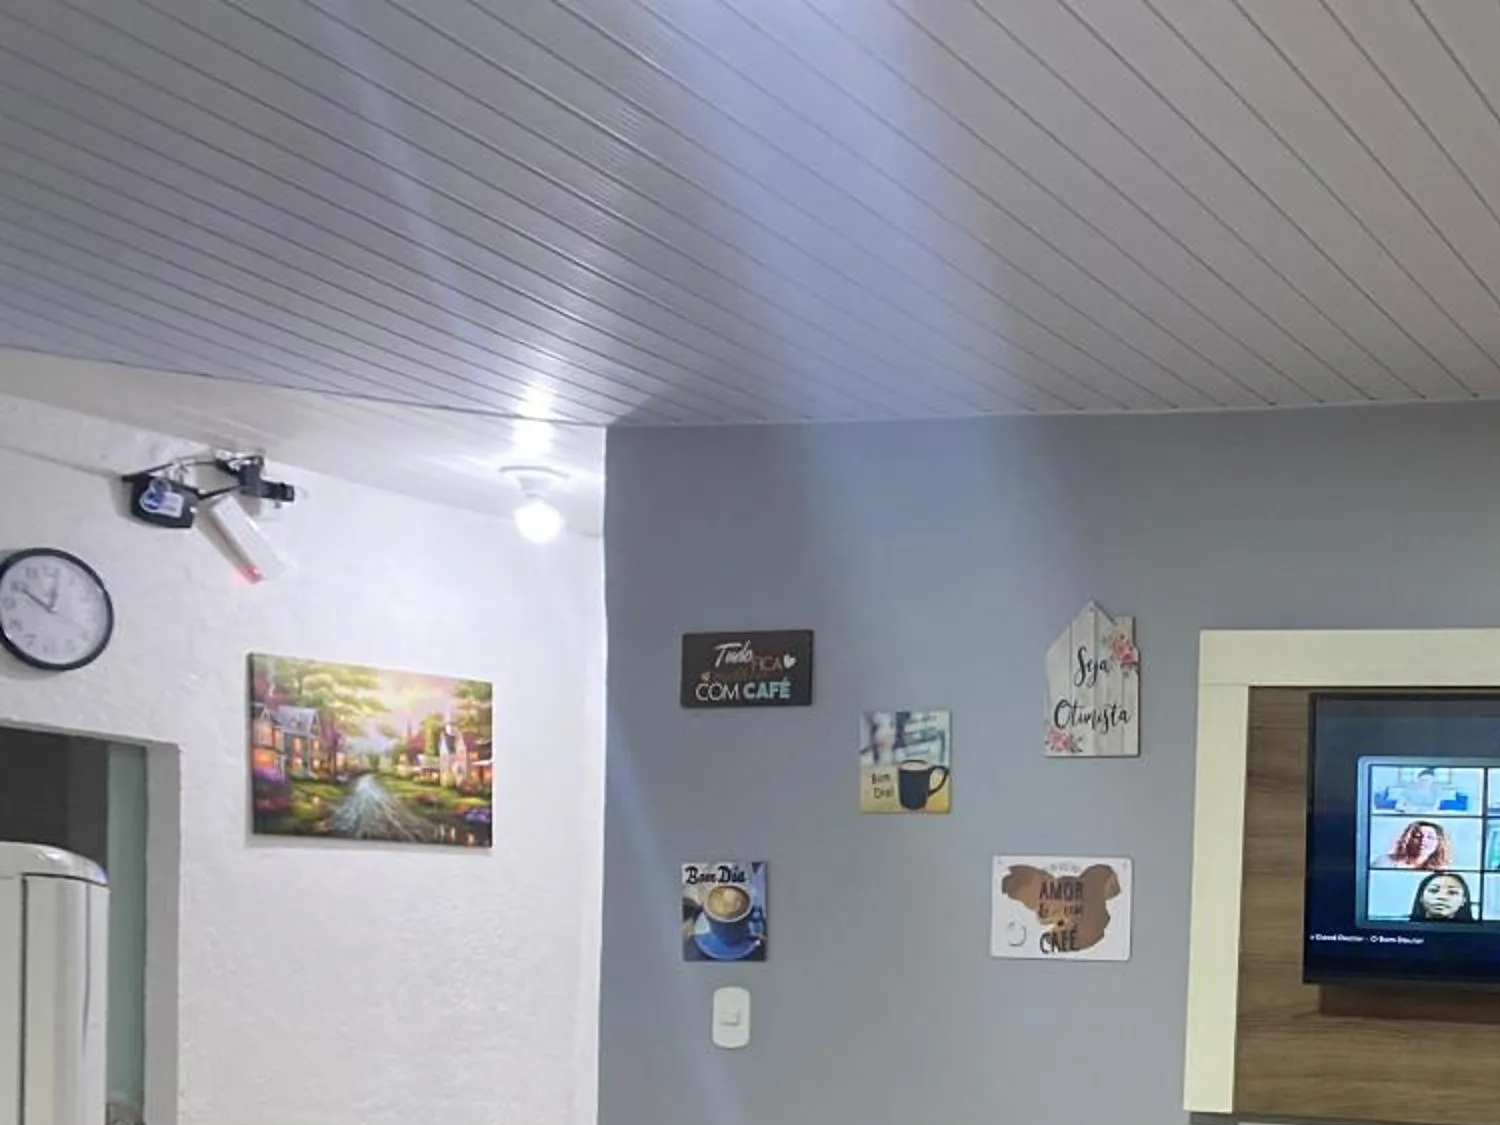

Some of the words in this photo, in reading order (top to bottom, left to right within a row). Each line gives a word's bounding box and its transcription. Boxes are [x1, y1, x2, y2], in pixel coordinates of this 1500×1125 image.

[713, 640, 753, 668] Tudo
[695, 683, 739, 701] COM
[743, 676, 792, 699] CAFÉ
[1054, 699, 1130, 734] Otimista
[718, 865, 746, 882] Dia
[1039, 881, 1084, 900] AMOR
